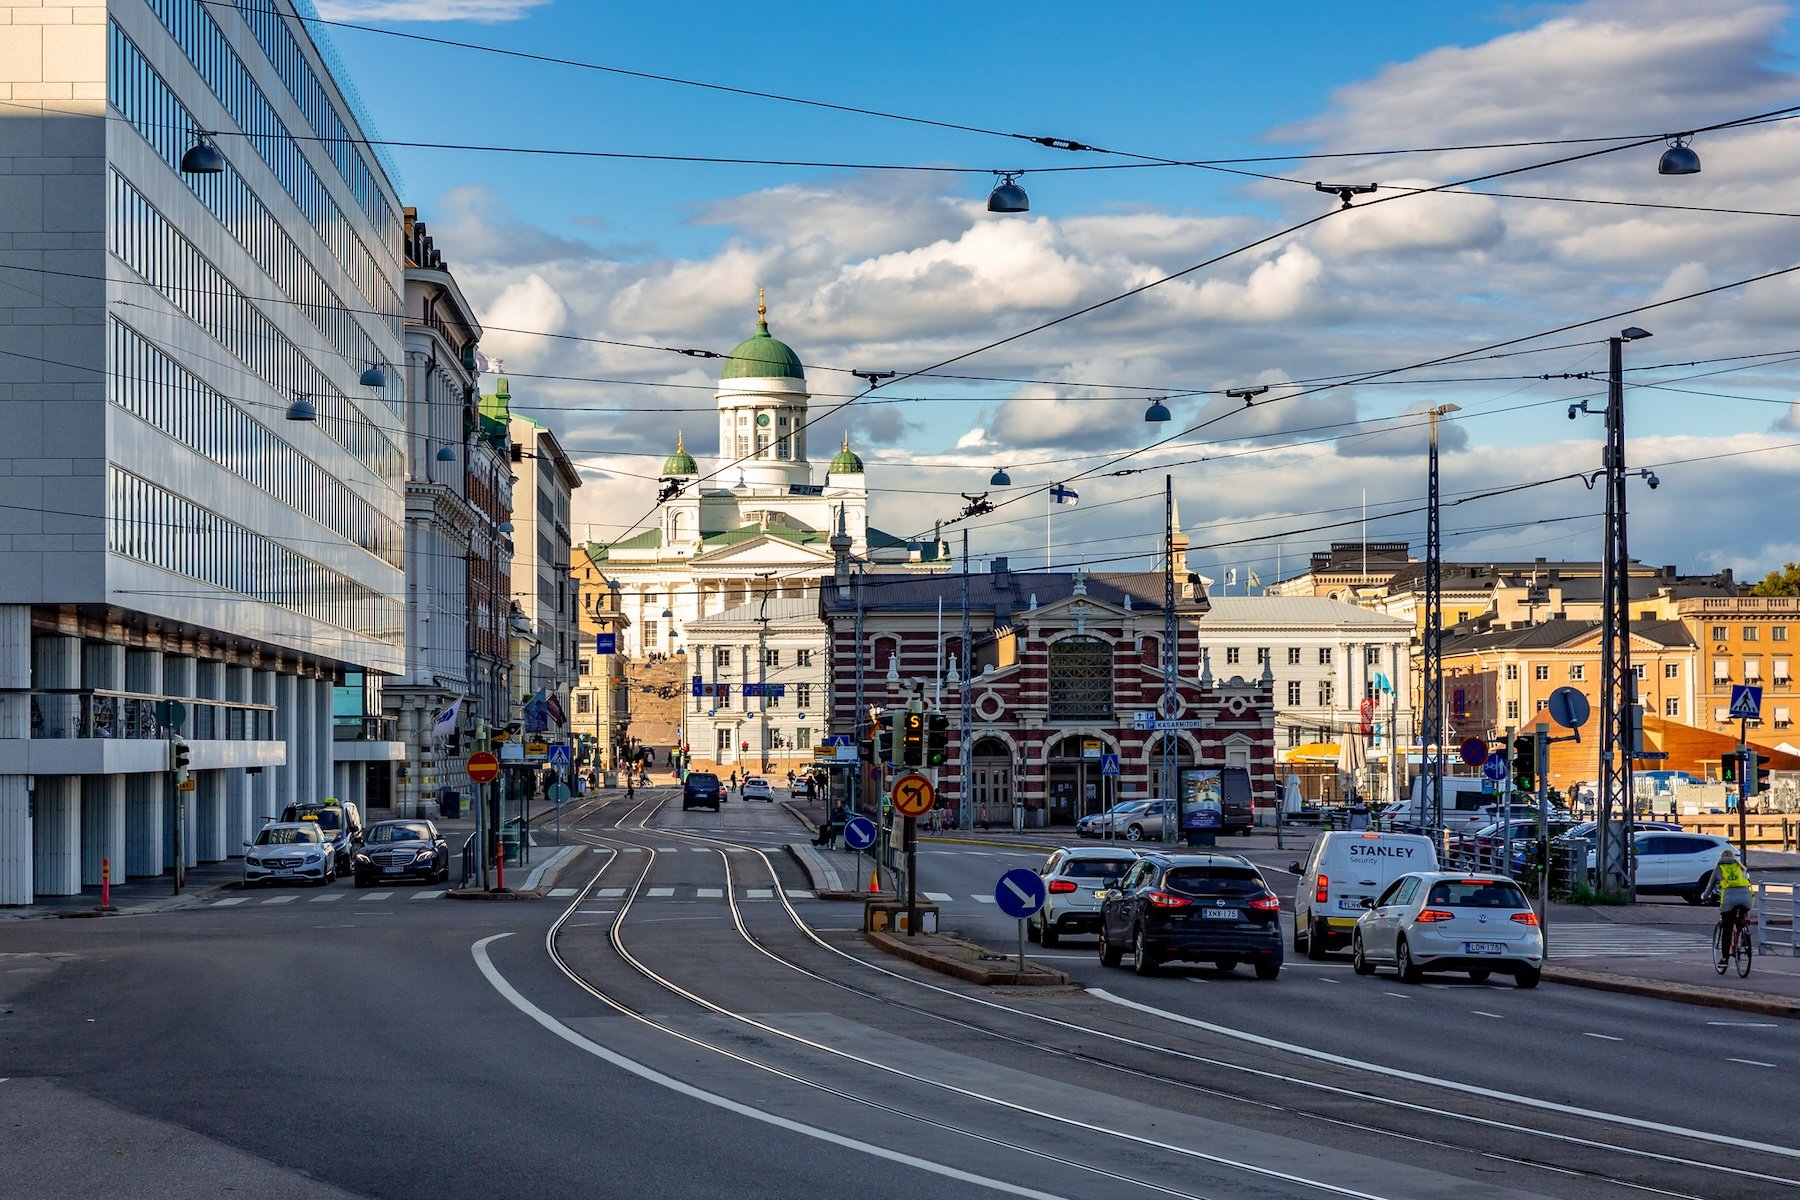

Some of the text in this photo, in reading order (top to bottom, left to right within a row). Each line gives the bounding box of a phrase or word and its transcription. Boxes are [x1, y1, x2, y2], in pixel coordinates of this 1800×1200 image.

[910, 715, 920, 728] S
[1350, 845, 1414, 858] STANLEY
[1350, 857, 1378, 865] Security
